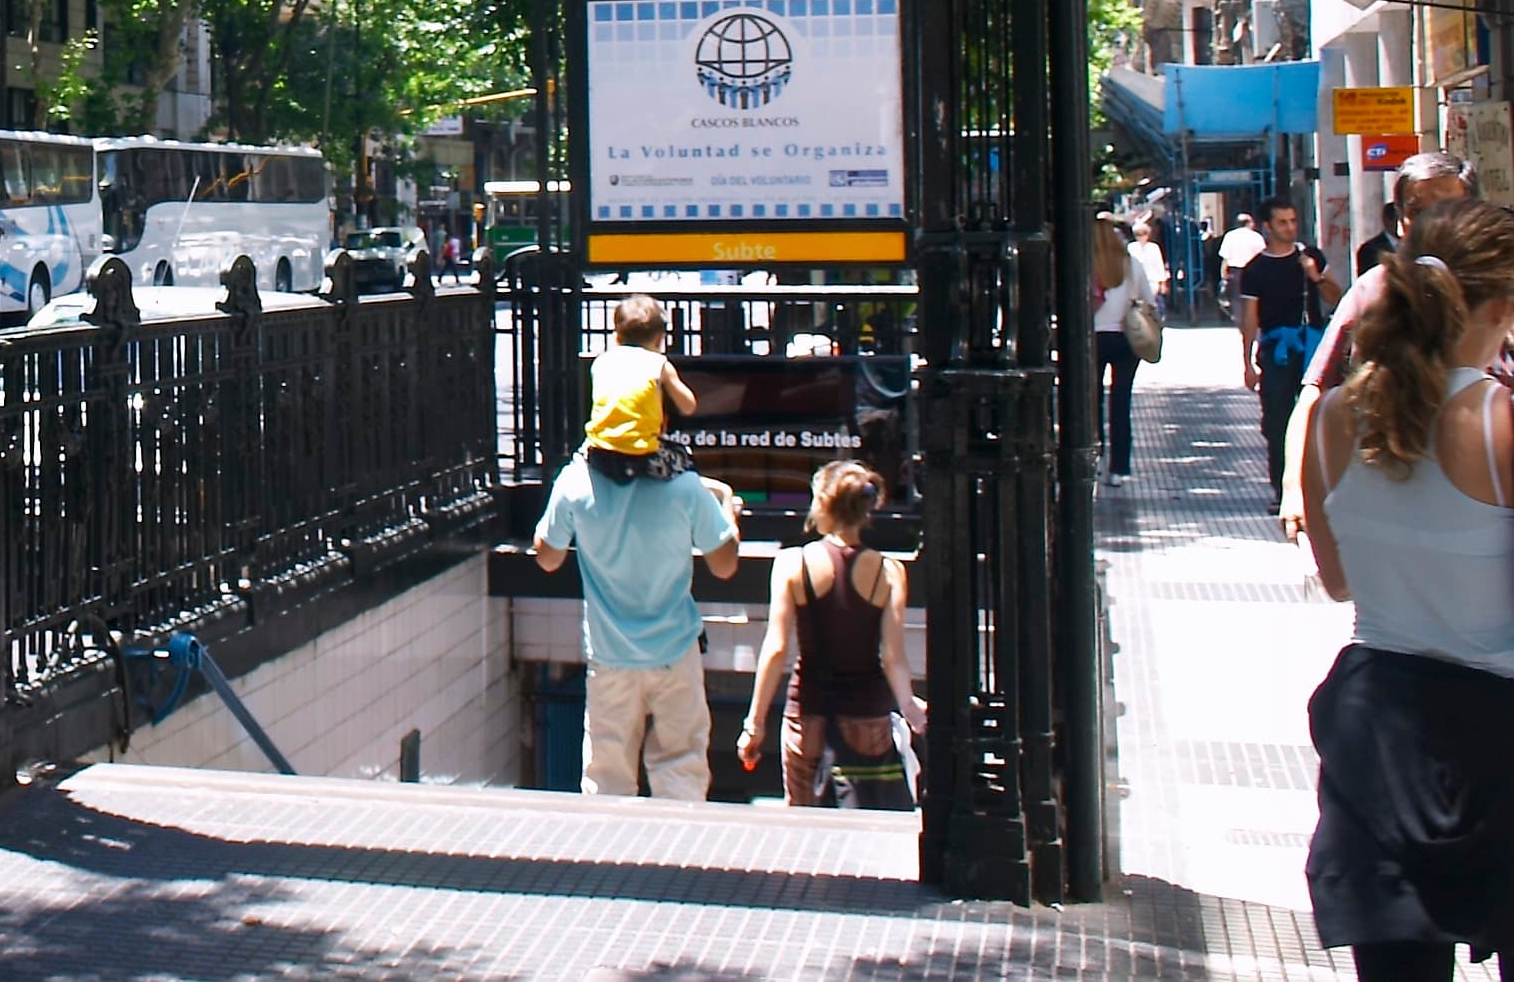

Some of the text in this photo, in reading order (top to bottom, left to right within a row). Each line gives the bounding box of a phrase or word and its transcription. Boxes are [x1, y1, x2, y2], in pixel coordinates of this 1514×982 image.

[691, 116, 800, 129] CASCOS BLANCOS
[608, 142, 887, 161] La Voluntad se Organiza
[713, 242, 776, 261] Subte
[695, 430, 717, 446] de
[721, 430, 736, 446] la
[741, 431, 770, 446] red
[775, 431, 796, 447] de
[801, 431, 861, 448] Subtes
